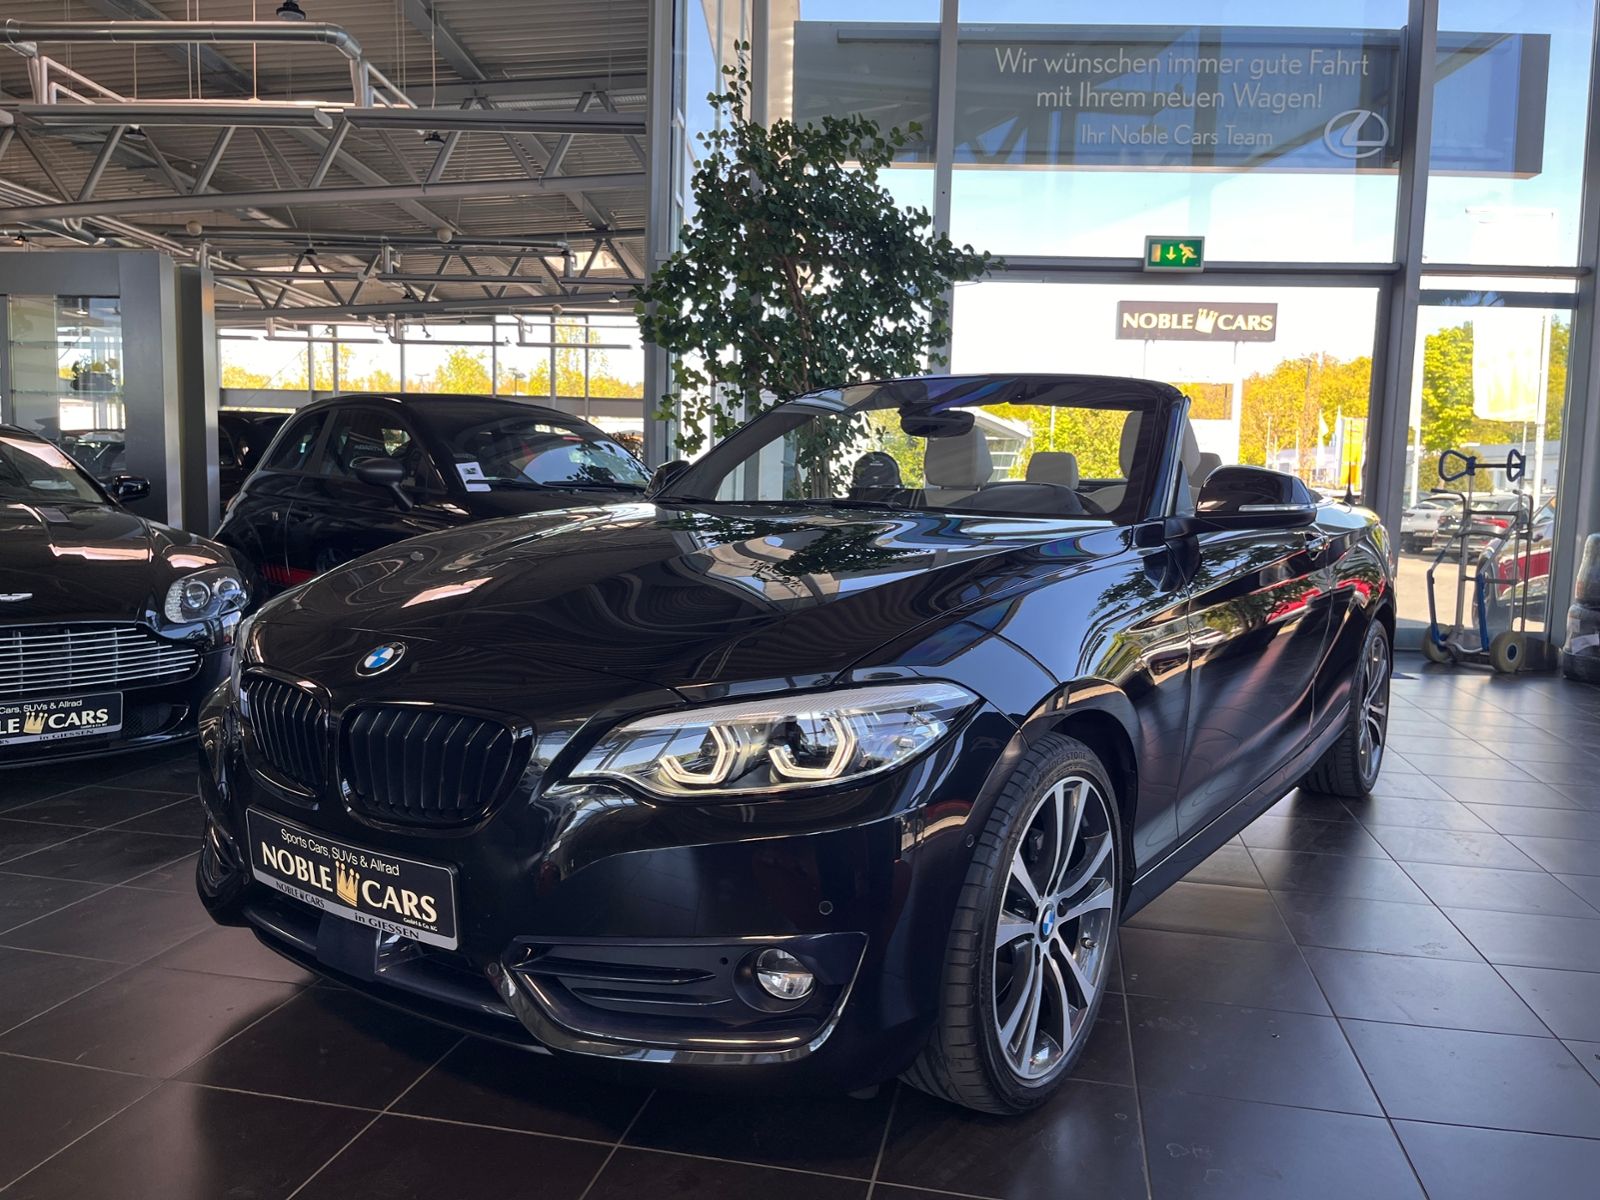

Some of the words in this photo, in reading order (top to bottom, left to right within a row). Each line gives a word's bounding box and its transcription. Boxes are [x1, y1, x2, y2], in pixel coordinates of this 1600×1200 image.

[994, 47, 1038, 74] Wir
[1043, 47, 1161, 74] wünschen
[1167, 51, 1244, 75] immer
[1249, 53, 1303, 80] gute
[1309, 49, 1369, 76] Fahrt
[1036, 85, 1072, 108] mit
[1078, 81, 1146, 108] Ihrem
[1152, 91, 1225, 108] neuen
[1232, 82, 1323, 114] Wagen!
[1080, 124, 1105, 145] Ihr
[1111, 124, 1169, 145] Noble
[1173, 124, 1219, 146] Cars
[1224, 124, 1274, 146] Team
[1122, 312, 1194, 330] NOBLE
[1216, 314, 1274, 332] CARS
[23, 703, 48, 712] SUVs
[49, 701, 57, 709] &
[58, 699, 83, 708] Allrad
[48, 708, 109, 729] CARS
[281, 828, 308, 849] Sports
[308, 839, 331, 858] Cars,
[331, 846, 359, 865] SUVs
[359, 855, 369, 868] &
[370, 858, 400, 876] Allrad
[261, 841, 334, 893] NOBLE
[361, 879, 438, 923] CARS
[275, 880, 299, 898] NOBLE
[305, 893, 325, 909] CARS
[354, 912, 365, 923] in
[368, 918, 420, 939] GIESSEN
